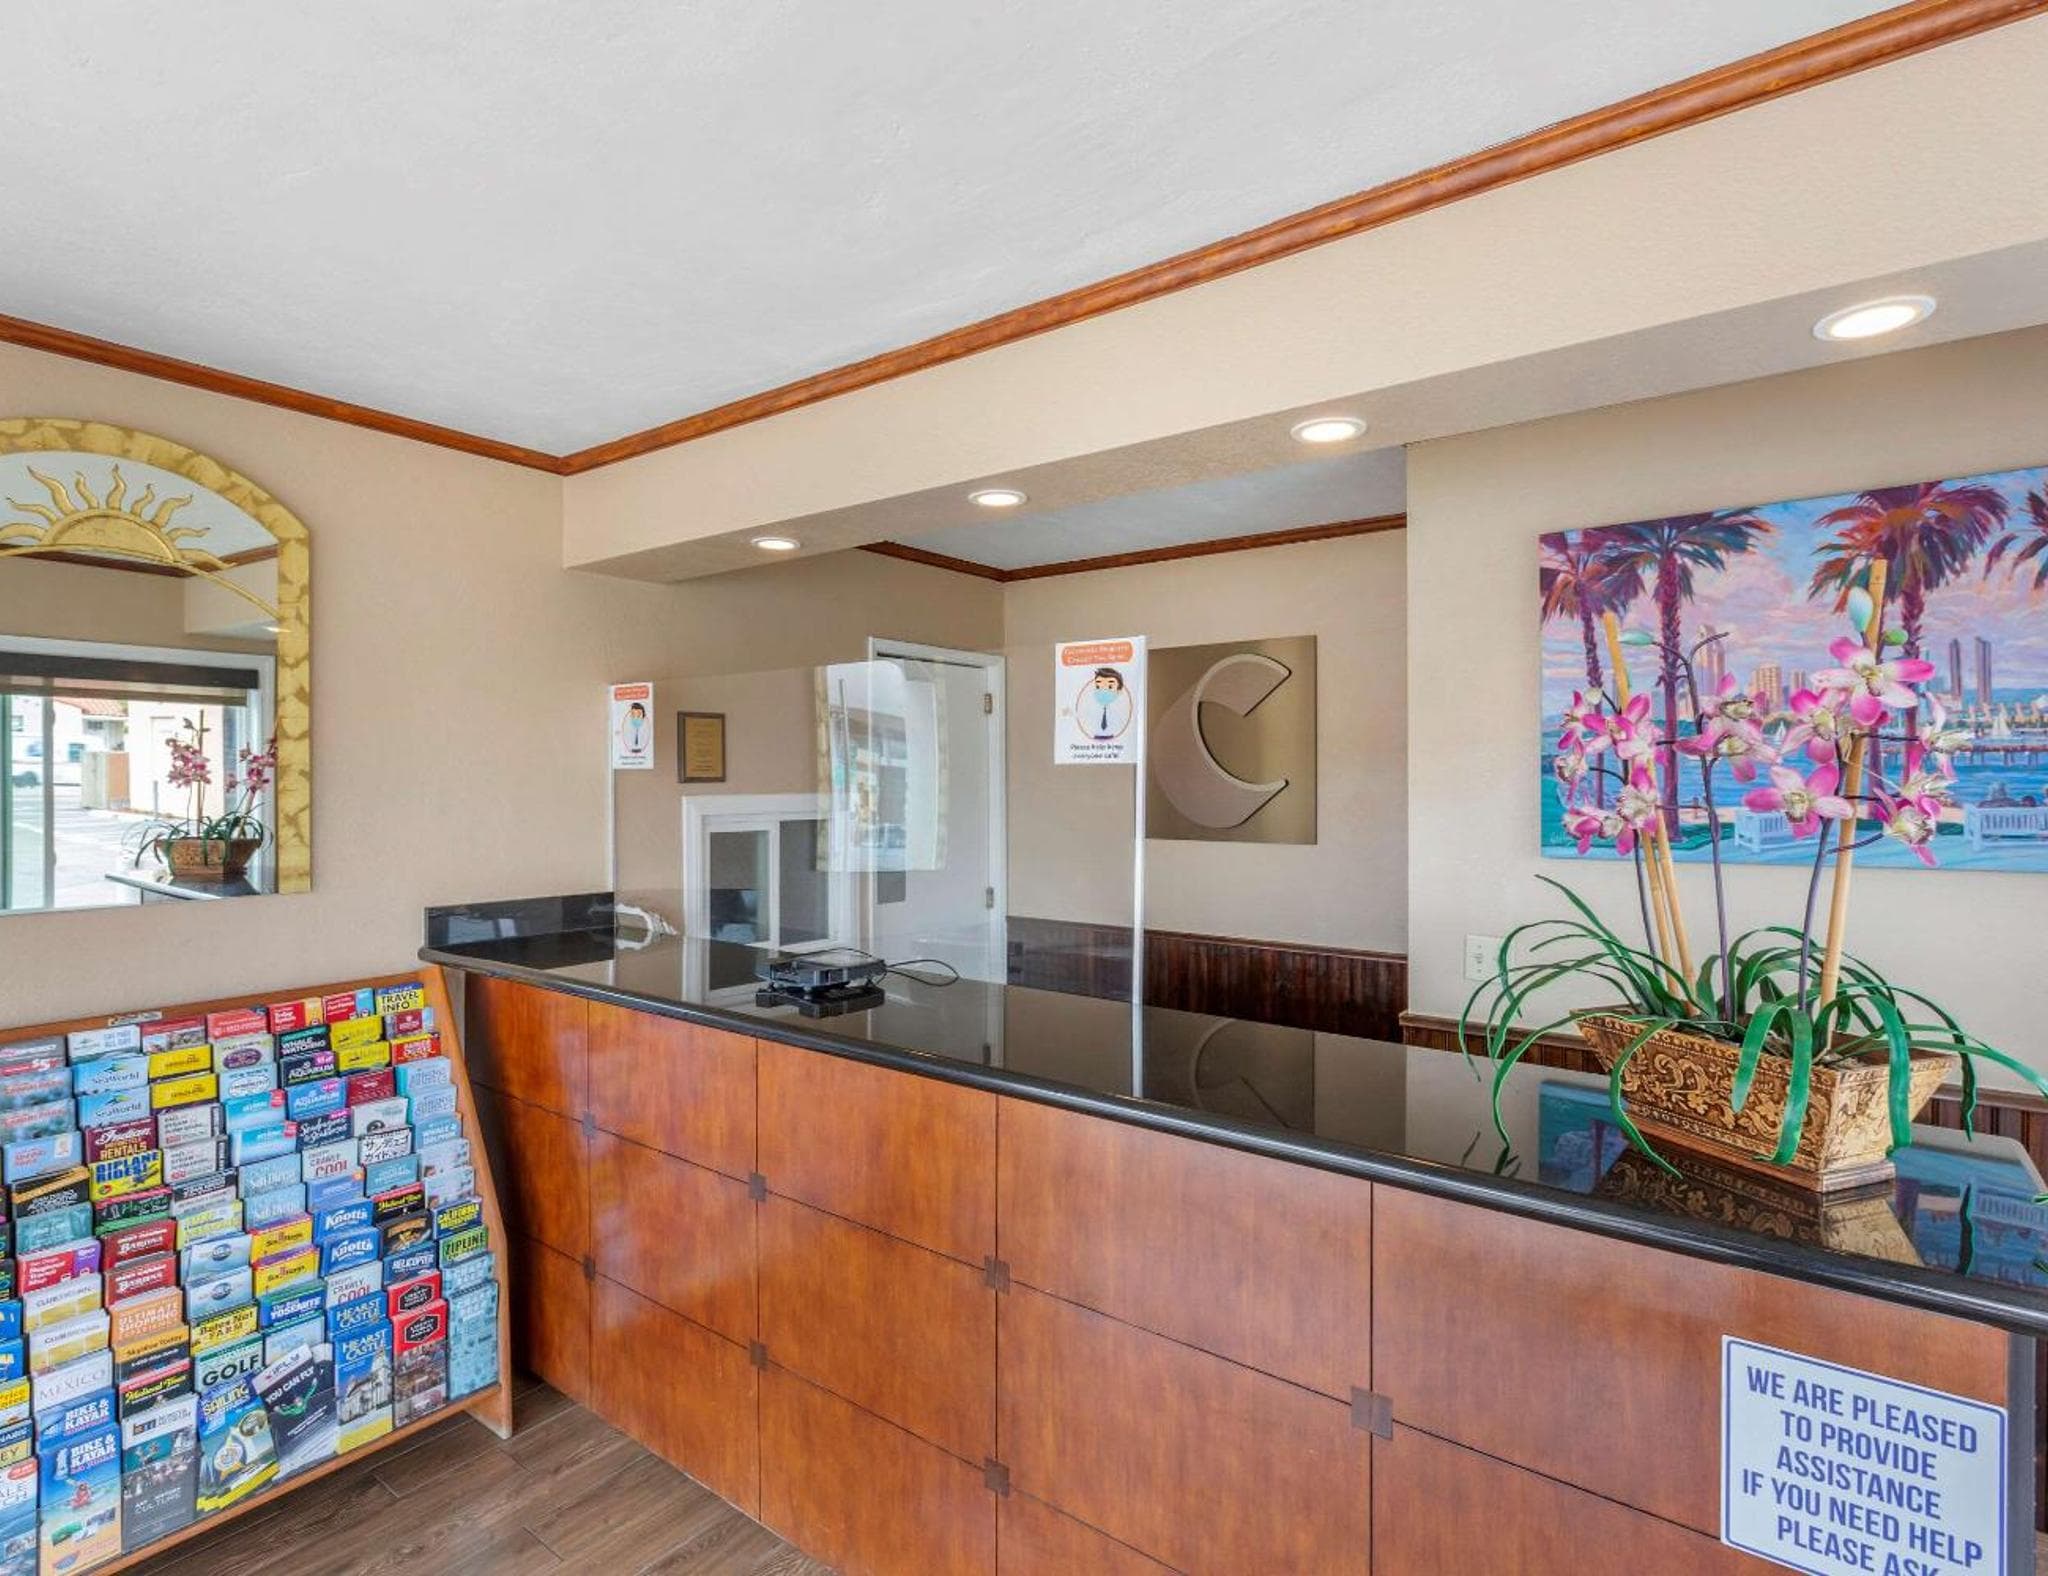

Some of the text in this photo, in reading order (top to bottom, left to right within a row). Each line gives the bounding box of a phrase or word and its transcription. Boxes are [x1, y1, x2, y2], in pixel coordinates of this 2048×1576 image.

[381, 992, 419, 1003] TRAVEL
[383, 1001, 410, 1013] INFO
[101, 1143, 147, 1160] RENTALS
[337, 1299, 380, 1321] HEARST
[342, 1328, 386, 1353] HEARST
[203, 1354, 259, 1386] GOLF
[266, 1366, 315, 1404] YOU CAN FLY
[65, 1407, 110, 1431] KAYAK
[66, 1398, 109, 1419] BIKE &
[1747, 1365, 1978, 1454] WE ARE PLEASED
[71, 1433, 116, 1455] BIKE &
[71, 1442, 116, 1468] KAYAK
[1780, 1410, 1938, 1481] TO PROVIDE
[1776, 1445, 1942, 1520] ASSISTANCE
[1743, 1468, 1984, 1569] IF YOU NEED HELP
[1777, 1515, 1940, 1576] PLEASE ASK
